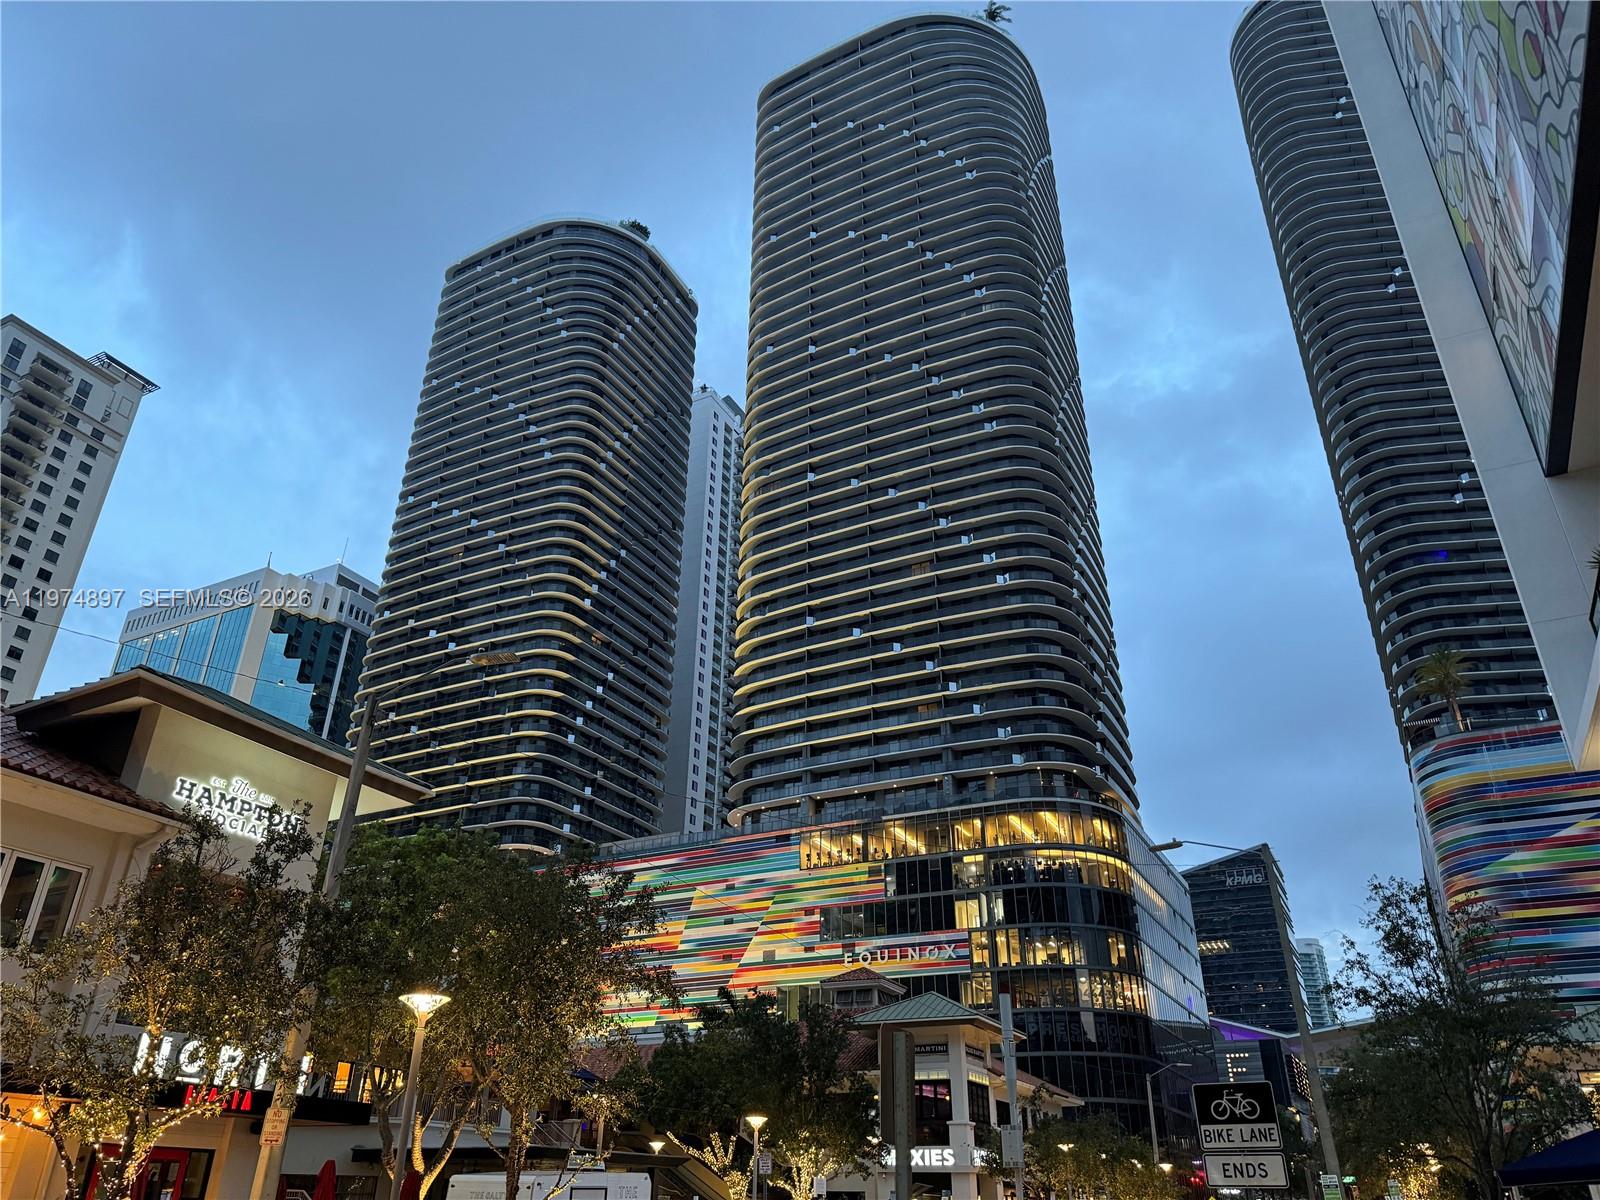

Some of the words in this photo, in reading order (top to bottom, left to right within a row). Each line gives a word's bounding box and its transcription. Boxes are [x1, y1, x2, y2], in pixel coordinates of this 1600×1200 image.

[231, 778, 258, 799] The
[175, 778, 301, 834] HAMPTON
[1226, 871, 1263, 886] KPMG
[844, 944, 957, 967] EQUINOX
[1028, 1022, 1137, 1041] PRESHOOL
[273, 1110, 282, 1118] NO
[1203, 1128, 1235, 1143] BIKE
[1239, 1127, 1277, 1142] LANE
[881, 1149, 955, 1165] MXIES
[1222, 1162, 1268, 1178] ENDS
